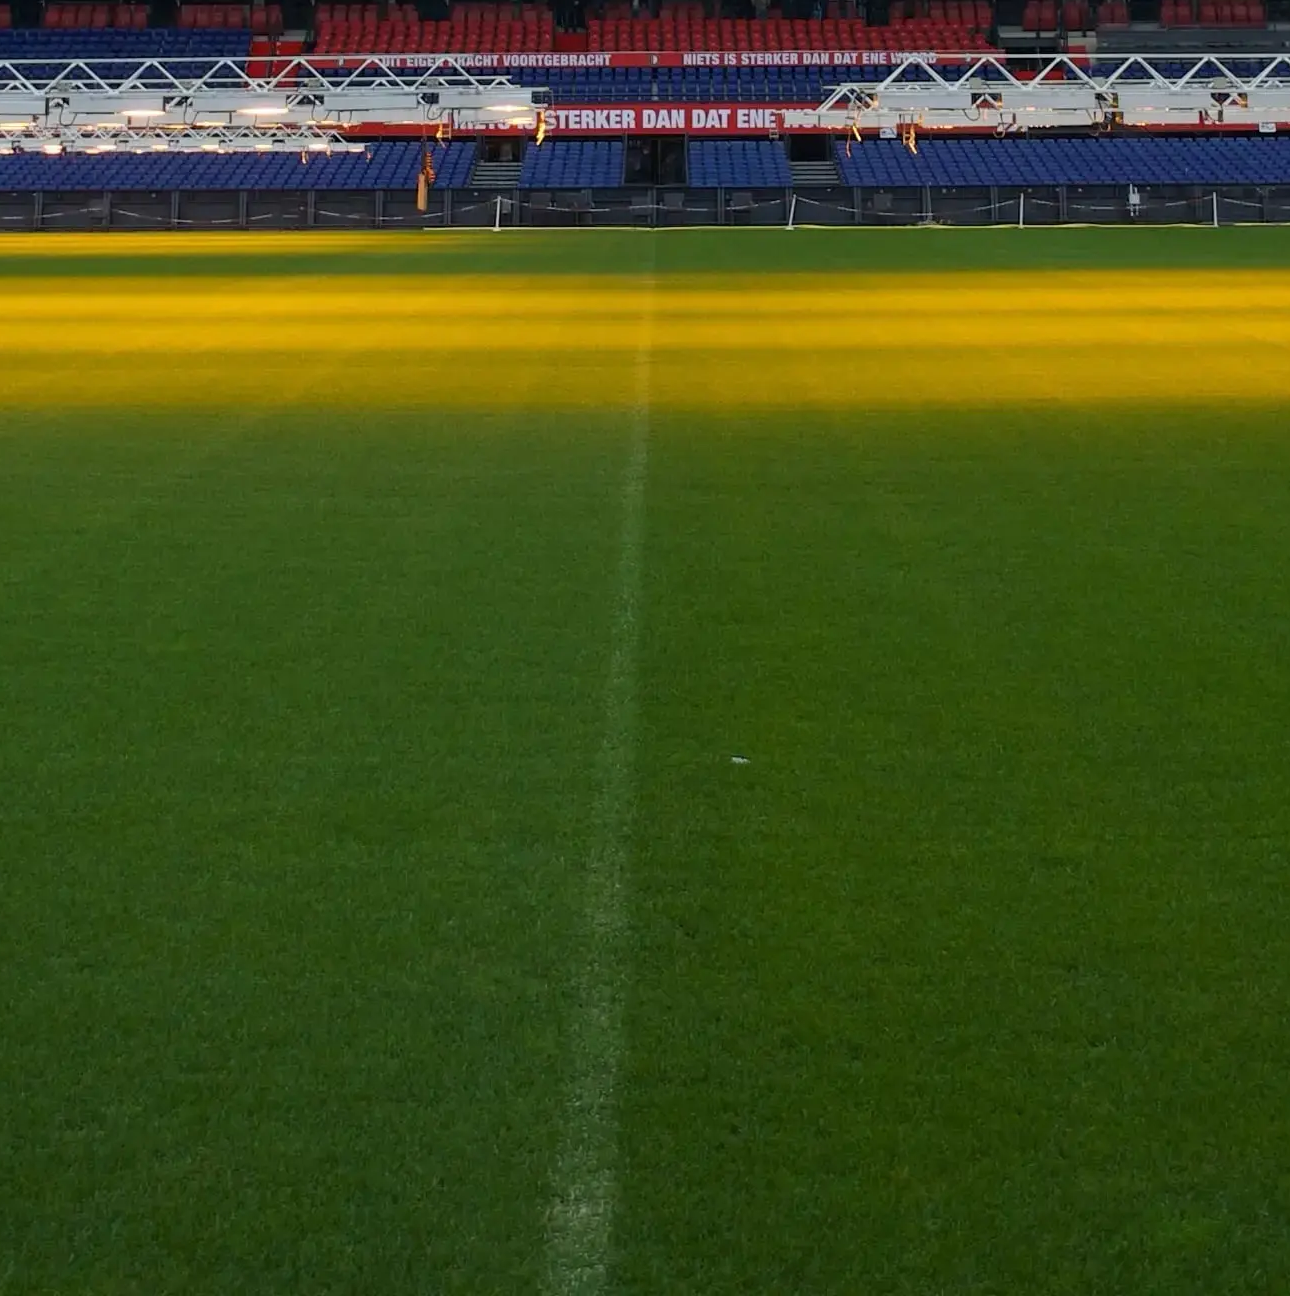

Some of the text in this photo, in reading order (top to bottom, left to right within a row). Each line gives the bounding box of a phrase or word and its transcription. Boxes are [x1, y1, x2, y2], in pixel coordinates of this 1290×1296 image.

[503, 54, 612, 67] VOORTGEBRACHT
[683, 53, 720, 66] NIETS
[724, 53, 737, 66] IS
[741, 53, 799, 65] STERKER
[803, 52, 830, 65] DAN
[834, 52, 858, 65] DAT
[862, 52, 887, 65] ENE
[543, 108, 637, 129] STERKER
[642, 108, 685, 128] DAN
[691, 108, 731, 128] DAT
[736, 108, 777, 128] ENE
